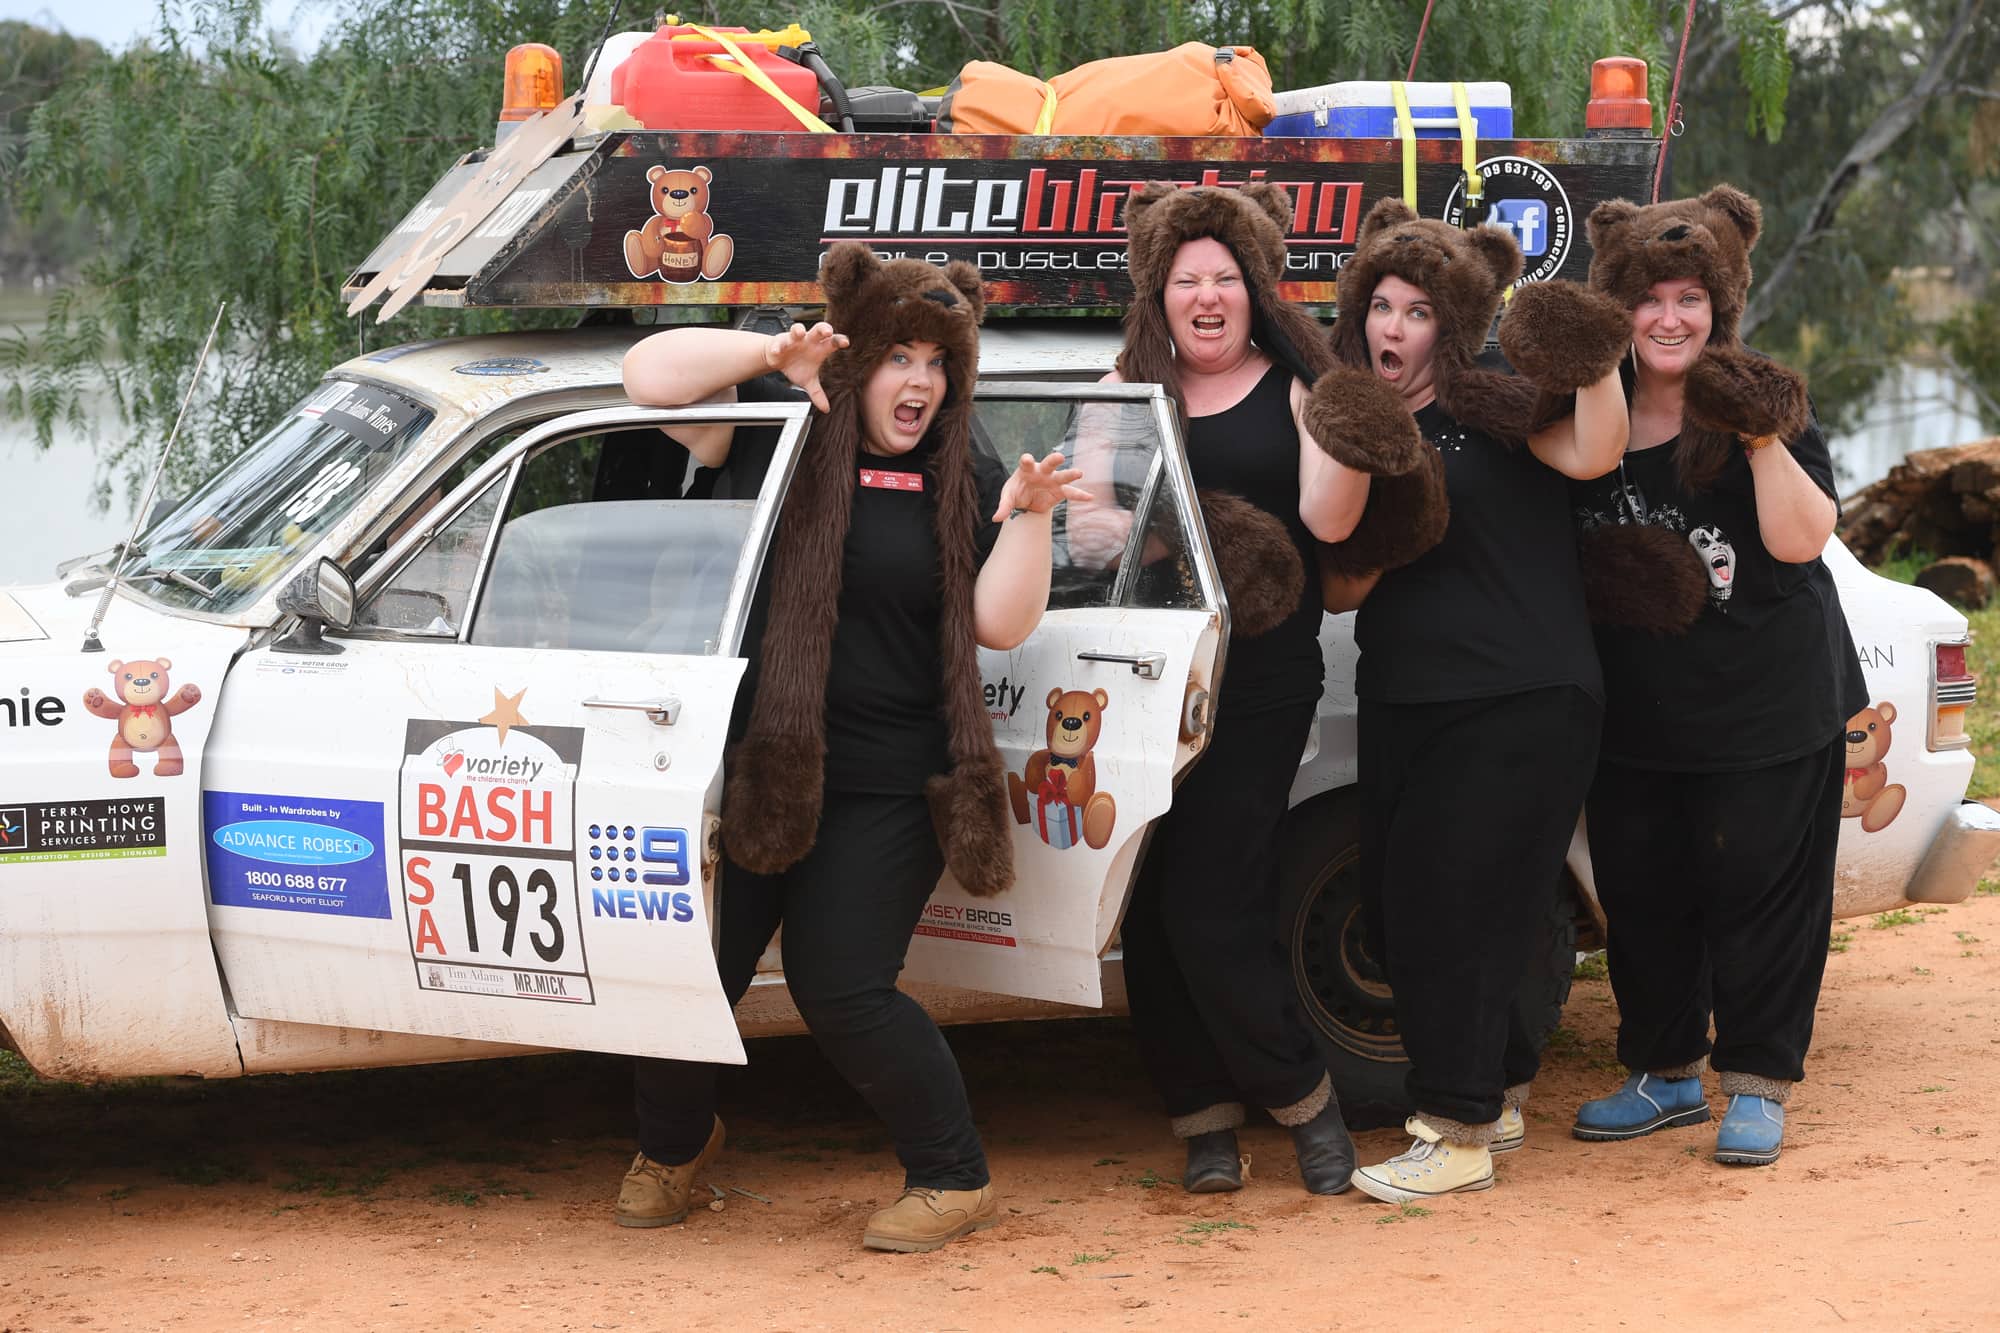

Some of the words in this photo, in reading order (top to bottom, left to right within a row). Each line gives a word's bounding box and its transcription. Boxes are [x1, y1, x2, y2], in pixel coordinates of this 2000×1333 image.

[1483, 163, 1501, 178] 09
[1504, 162, 1529, 177] 631
[1531, 169, 1553, 191] 199
[366, 403, 398, 435] Wines
[279, 456, 361, 523] 193
[1859, 644, 1895, 669] AN
[466, 754, 544, 782] variety
[39, 806, 88, 818] TERRY
[107, 803, 156, 815] HOWE
[242, 803, 263, 813] Built
[269, 805, 278, 813] In
[280, 806, 327, 817] Wardrobes
[329, 809, 341, 819] by
[418, 783, 553, 845] BASH
[41, 816, 156, 835] PRINTING
[40, 836, 97, 847] SERVICES
[106, 834, 126, 844] PTY
[135, 833, 157, 842] LTD
[222, 831, 297, 850] ADVANCE
[303, 837, 353, 855] ROBES
[20, 854, 69, 862] PROMOTION
[81, 852, 111, 860] DESIGN
[122, 850, 158, 858] SIGNAGE
[244, 870, 281, 887] 1800
[284, 874, 315, 890] 688
[318, 877, 347, 892] 677
[252, 893, 288, 904] SEAFORD
[296, 895, 317, 905] PORT
[318, 897, 345, 908] ELLIOT
[452, 862, 565, 963] 193
[592, 888, 694, 923] NEWS
[923, 903, 964, 920] MSEY
[965, 908, 1012, 926] BROS
[447, 966, 467, 979] Tim
[470, 968, 505, 983] Adams
[513, 972, 567, 996] MR.MICK
